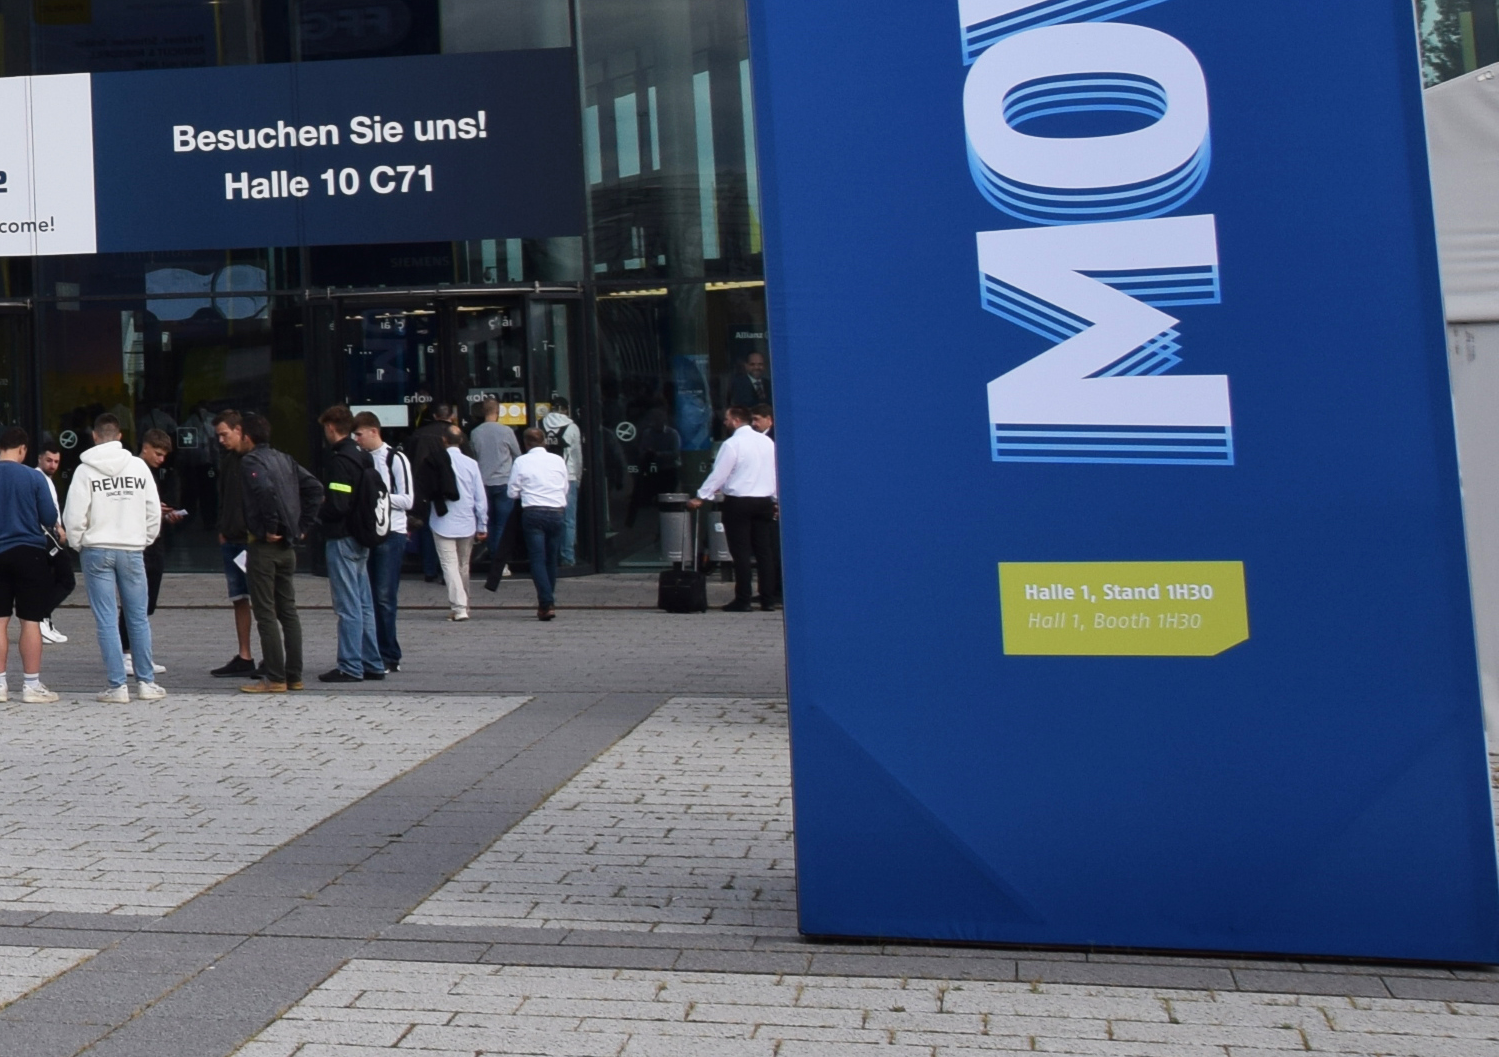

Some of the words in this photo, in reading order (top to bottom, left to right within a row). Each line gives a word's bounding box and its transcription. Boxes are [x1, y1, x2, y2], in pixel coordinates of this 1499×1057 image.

[173, 120, 339, 153] Besuchen
[350, 115, 403, 145] Sie
[414, 110, 487, 141] uns!
[225, 170, 309, 200] Halle
[320, 167, 359, 197] 10
[369, 165, 433, 195] C71
[92, 477, 146, 493] REVIEW
[1024, 583, 1074, 601] Halle
[1081, 583, 1096, 603] 1,
[1103, 583, 1161, 601] Stand
[1165, 583, 1213, 601] 1H30
[1028, 611, 1065, 629] Hall
[1070, 611, 1085, 631] 1,
[1093, 611, 1151, 629] Booth
[1157, 611, 1201, 629] 1H30
